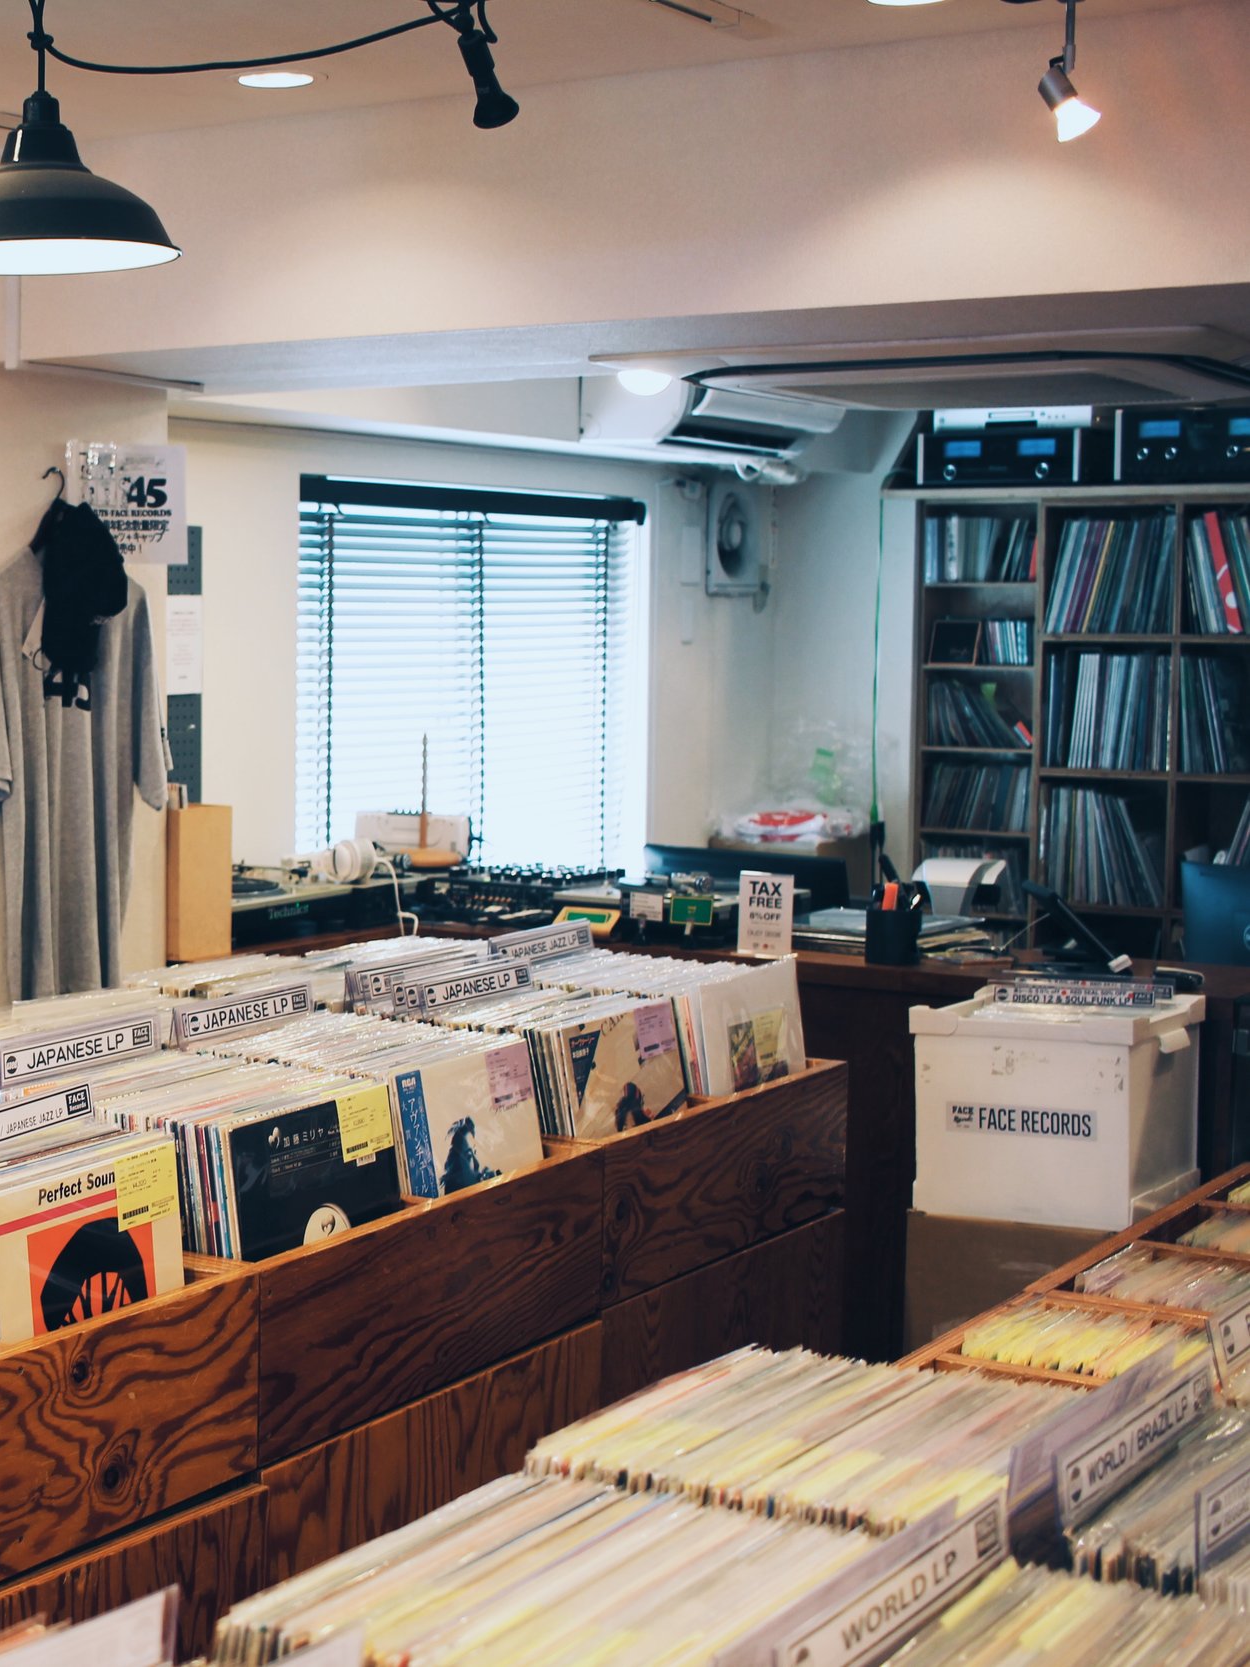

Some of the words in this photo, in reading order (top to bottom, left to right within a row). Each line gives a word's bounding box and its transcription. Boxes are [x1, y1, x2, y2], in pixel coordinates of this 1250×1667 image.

[131, 509, 172, 517] RECORDS
[749, 881, 782, 896] TAX
[749, 896, 782, 909] FREE
[512, 941, 548, 959] JAPANESE
[550, 937, 567, 951] JAZZ
[568, 934, 577, 946] LP
[442, 976, 497, 1001] JAPANESE
[498, 973, 511, 988] LP
[1012, 994, 1039, 1003] DISCO
[203, 1001, 270, 1030] JAPANESE
[273, 998, 289, 1016] LP
[133, 1027, 149, 1037] FACE
[27, 1037, 103, 1069] JAPANESE
[106, 1033, 124, 1051] LP
[68, 1092, 86, 1104] FACE
[6, 1117, 37, 1134] JAPANESE
[38, 1111, 54, 1127] JAZZ
[55, 1108, 64, 1119] LP
[978, 1107, 1016, 1132] FACE
[1021, 1109, 1092, 1138] RECORDS
[37, 1178, 82, 1206] Perfect
[86, 1170, 116, 1191] Soun
[1088, 1440, 1127, 1485] WORLD
[1137, 1412, 1174, 1451] BRAZIL
[1175, 1395, 1188, 1423] LP
[840, 1573, 928, 1651] WORLD
[933, 1550, 958, 1588] LP
